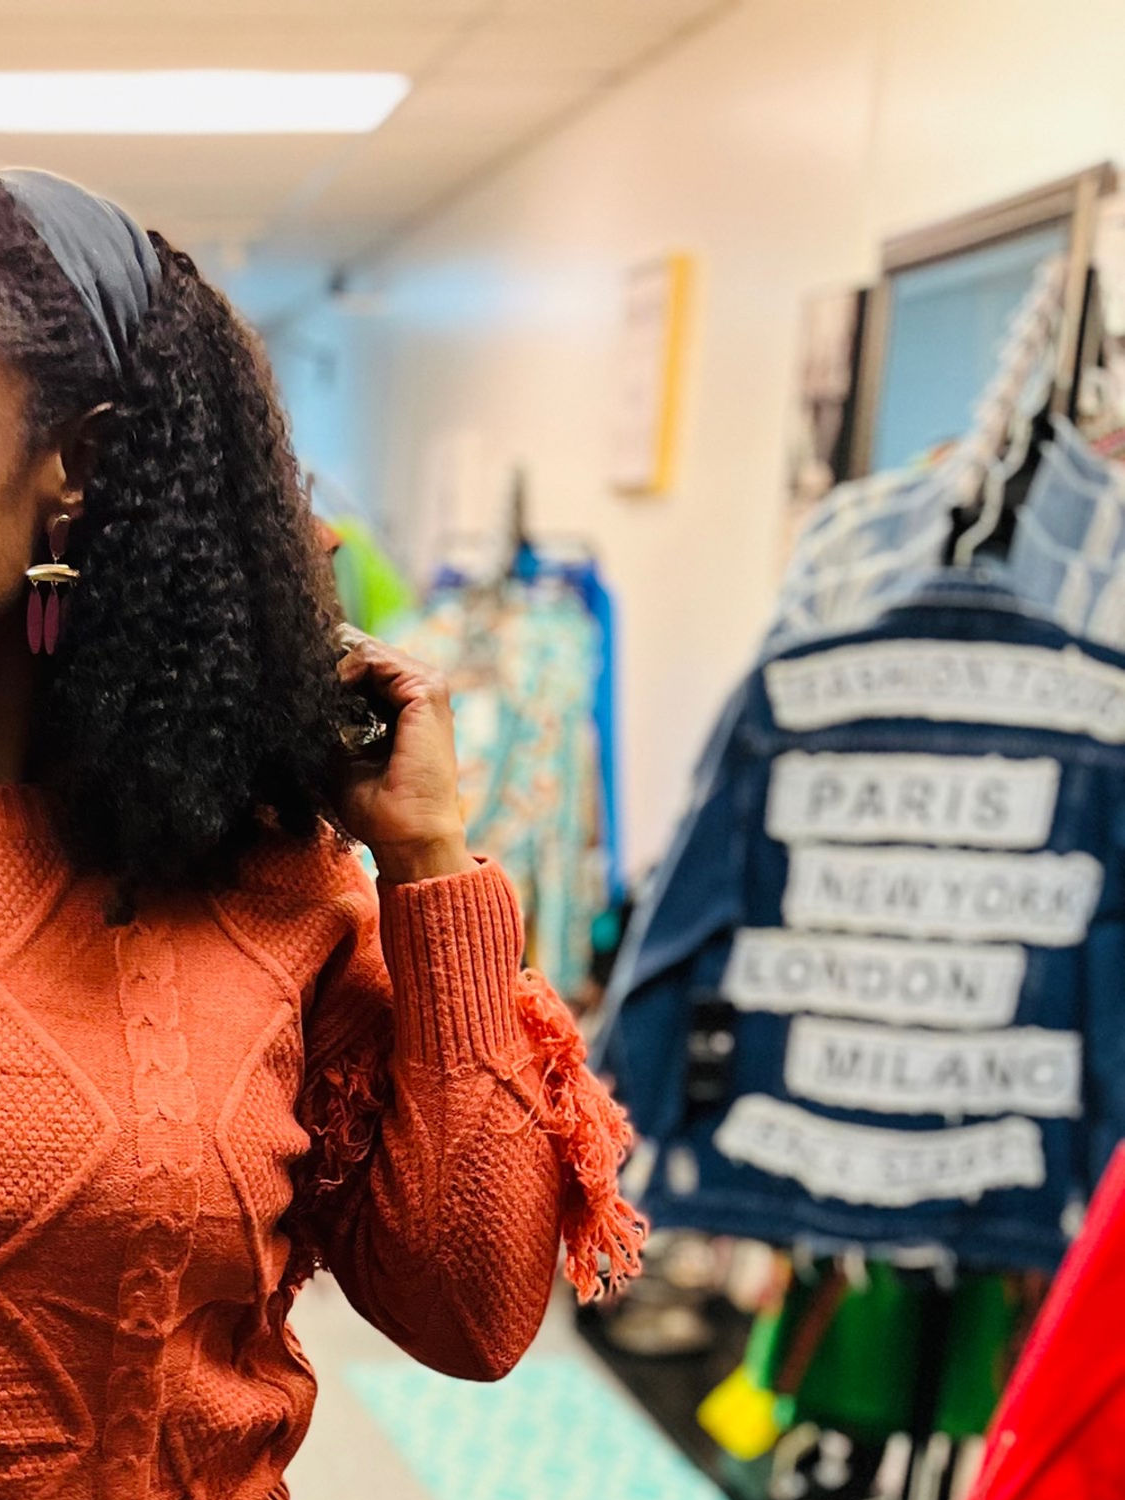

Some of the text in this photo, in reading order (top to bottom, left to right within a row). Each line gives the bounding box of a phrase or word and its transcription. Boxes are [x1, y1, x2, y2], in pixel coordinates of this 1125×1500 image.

[805, 772, 1010, 830] PARIS
[818, 862, 1077, 921] NEW YORK
[743, 944, 984, 1003] LONDON
[821, 1036, 1067, 1094] MILANO
